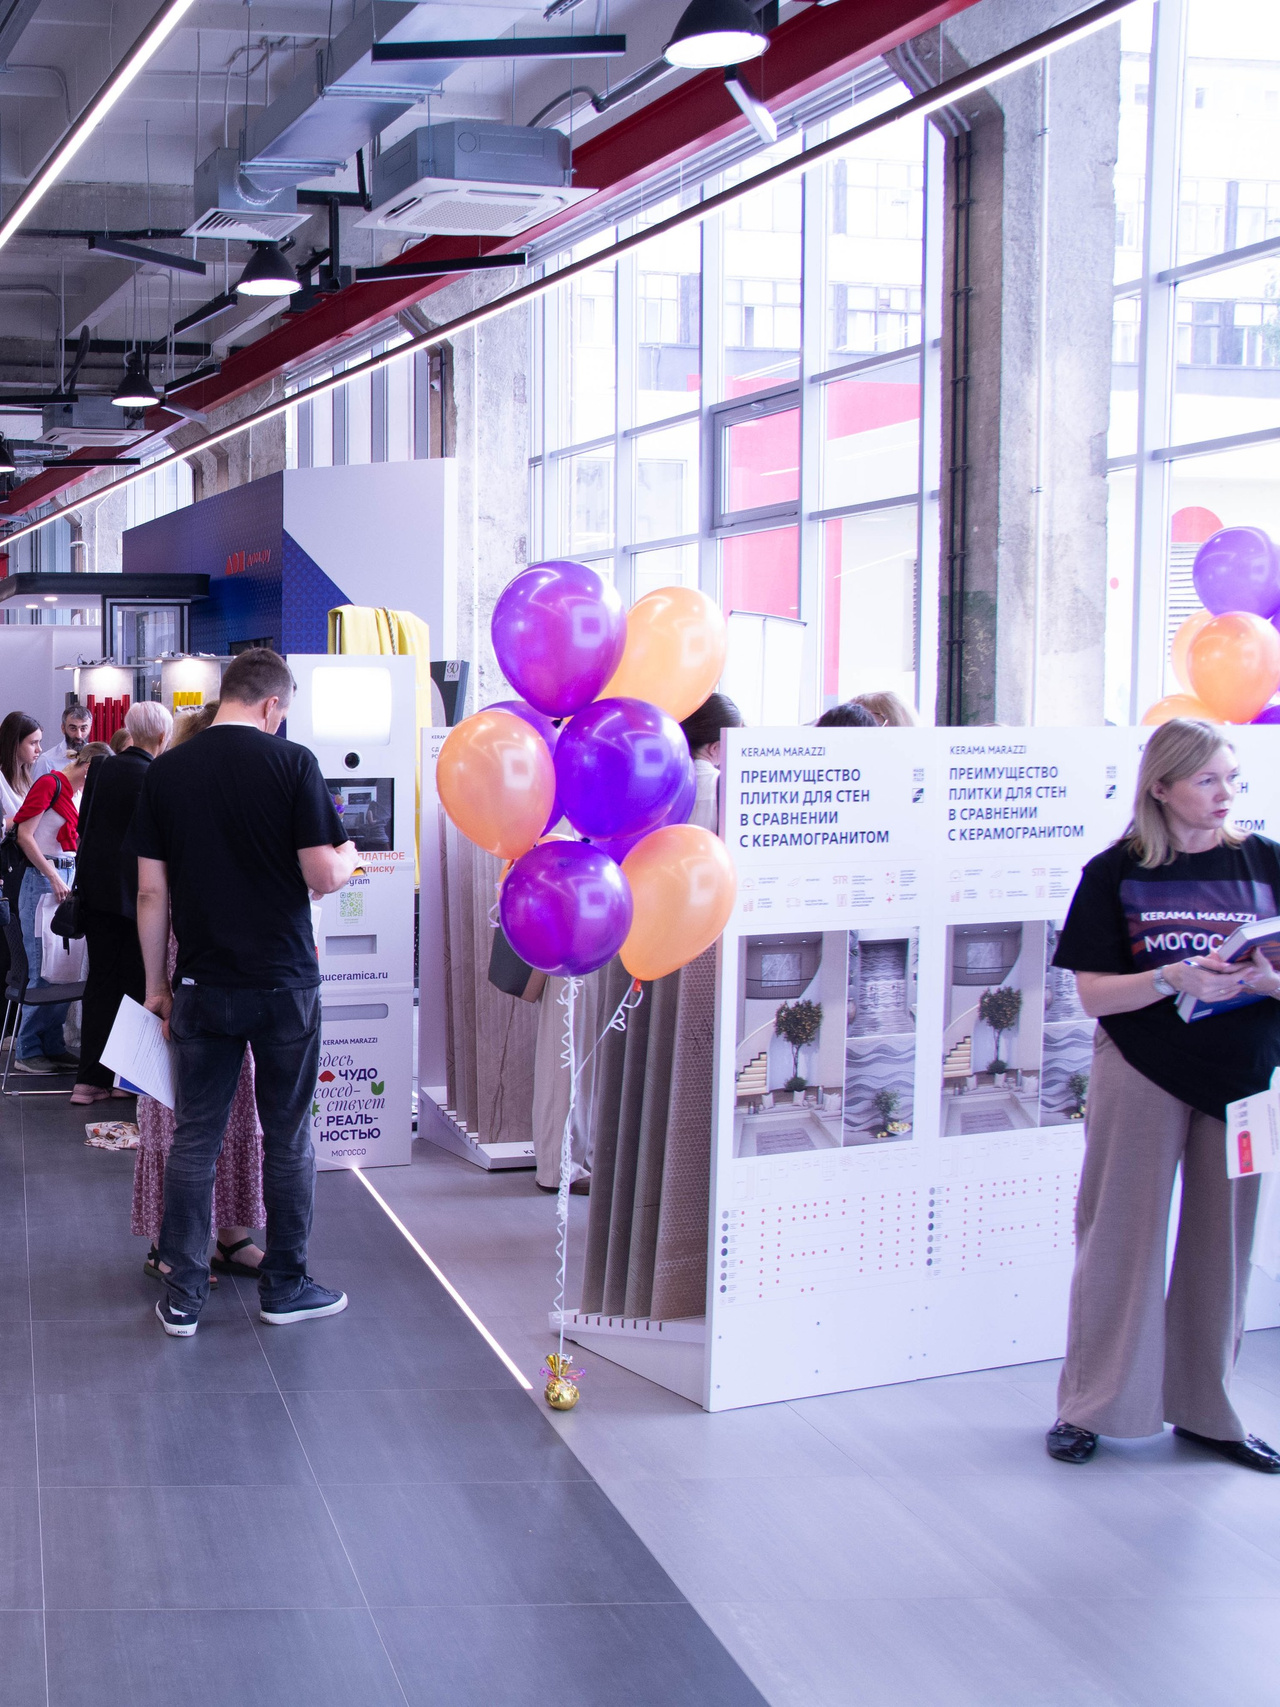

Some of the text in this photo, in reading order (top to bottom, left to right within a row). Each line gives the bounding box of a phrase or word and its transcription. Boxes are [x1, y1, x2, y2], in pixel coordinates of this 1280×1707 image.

[741, 746, 826, 757] KERAMA MARAZZI
[950, 745, 1027, 755] KERAMA MARAZZI
[741, 769, 860, 784] ПРЕИМУЩЕСТВО
[949, 766, 1058, 781] ПРЕИМУЩЕСТВО
[740, 790, 870, 806] ПЛИТКИ ДЛЯ СТЕН
[949, 786, 1067, 801] ПЛИТКИ ДЛЯ СТЕН
[740, 811, 838, 826] В СРАВНЕНИИ
[948, 807, 1038, 820] В СРАВНЕНИИ
[740, 830, 889, 847] С КЕРАМОГРАНИТОМ
[948, 825, 1084, 841] С КЕРАМОГРАНИТОМ
[358, 852, 405, 861] ПЛАТНОЕ
[1141, 911, 1257, 923] KERAMA MARAZZI
[350, 1037, 378, 1045] MARAZZI
[338, 1068, 378, 1081] ЧУДО
[326, 1097, 386, 1114] ствует
[314, 1113, 379, 1128] с РЕАЛЬ-
[320, 1128, 381, 1142] НОСТЬЮ
